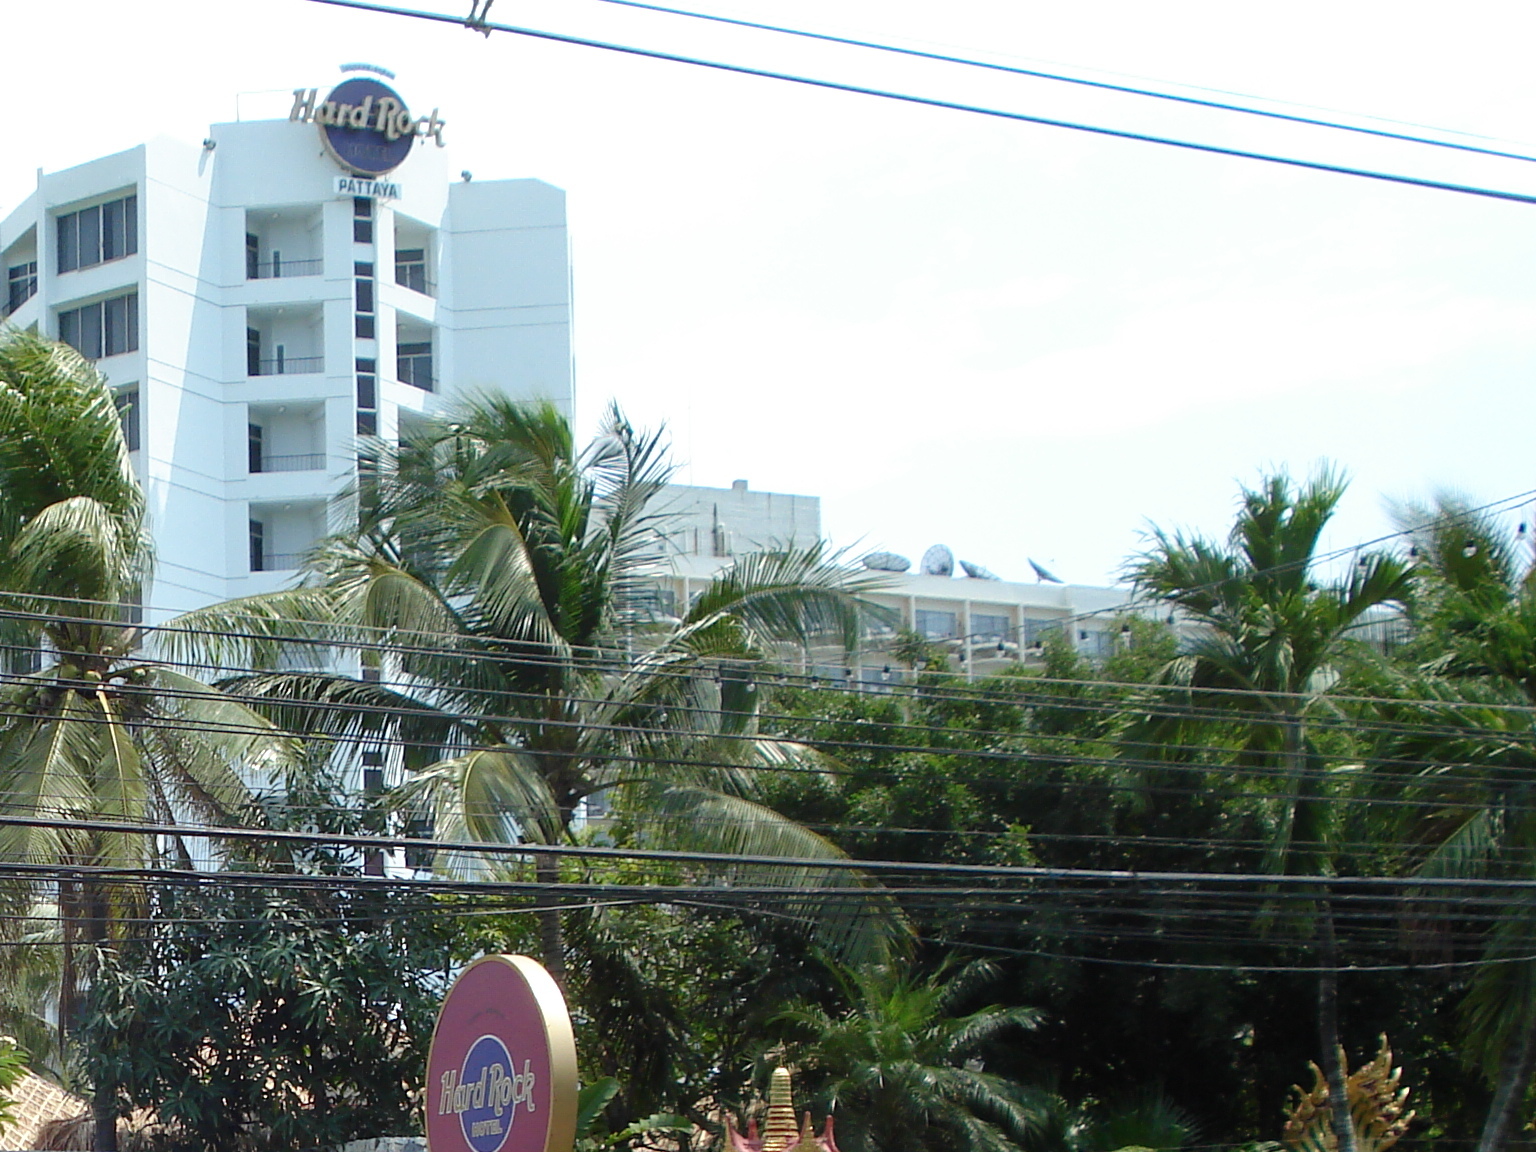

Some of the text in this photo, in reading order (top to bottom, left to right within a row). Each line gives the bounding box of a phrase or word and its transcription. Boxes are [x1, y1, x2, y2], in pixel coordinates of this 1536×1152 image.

[289, 88, 446, 148] Hard Rock
[338, 178, 398, 199] PATTAYA
[438, 1059, 536, 1117] Hard Rock
[471, 1118, 503, 1138] HOTEL
